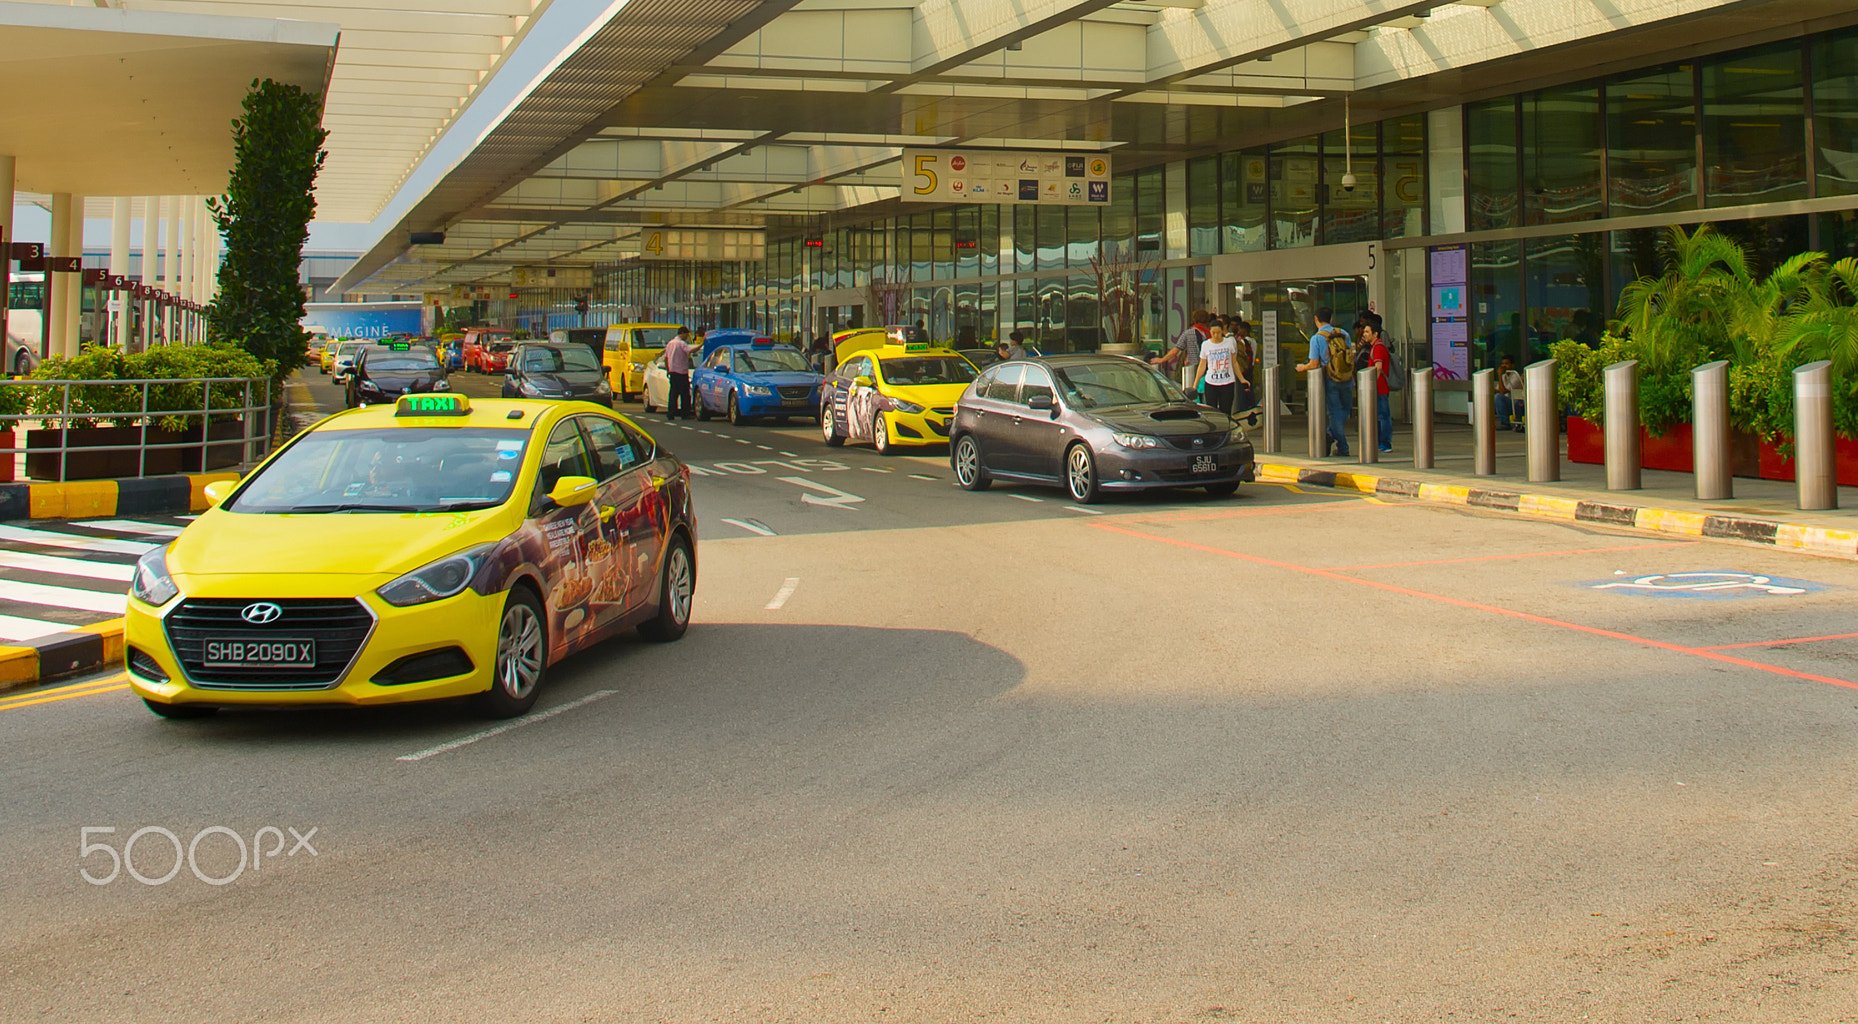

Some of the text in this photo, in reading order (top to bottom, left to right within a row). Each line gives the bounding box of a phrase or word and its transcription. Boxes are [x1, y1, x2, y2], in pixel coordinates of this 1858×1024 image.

[914, 155, 938, 195] 5
[646, 232, 663, 256] 4
[31, 245, 39, 258] 3
[1368, 244, 1376, 270] 5
[69, 259, 78, 271] 4
[99, 270, 106, 281] 5
[115, 276, 122, 286] 6
[515, 269, 526, 286] 3
[131, 281, 138, 290] 7
[144, 286, 151, 295] 8
[155, 290, 161, 298] 9
[453, 287, 461, 299] 2
[426, 295, 432, 305] 1
[1171, 279, 1185, 344] 5
[407, 397, 455, 411] TAXI
[1196, 456, 1212, 464] SJU
[207, 642, 311, 661] SHB2090X
